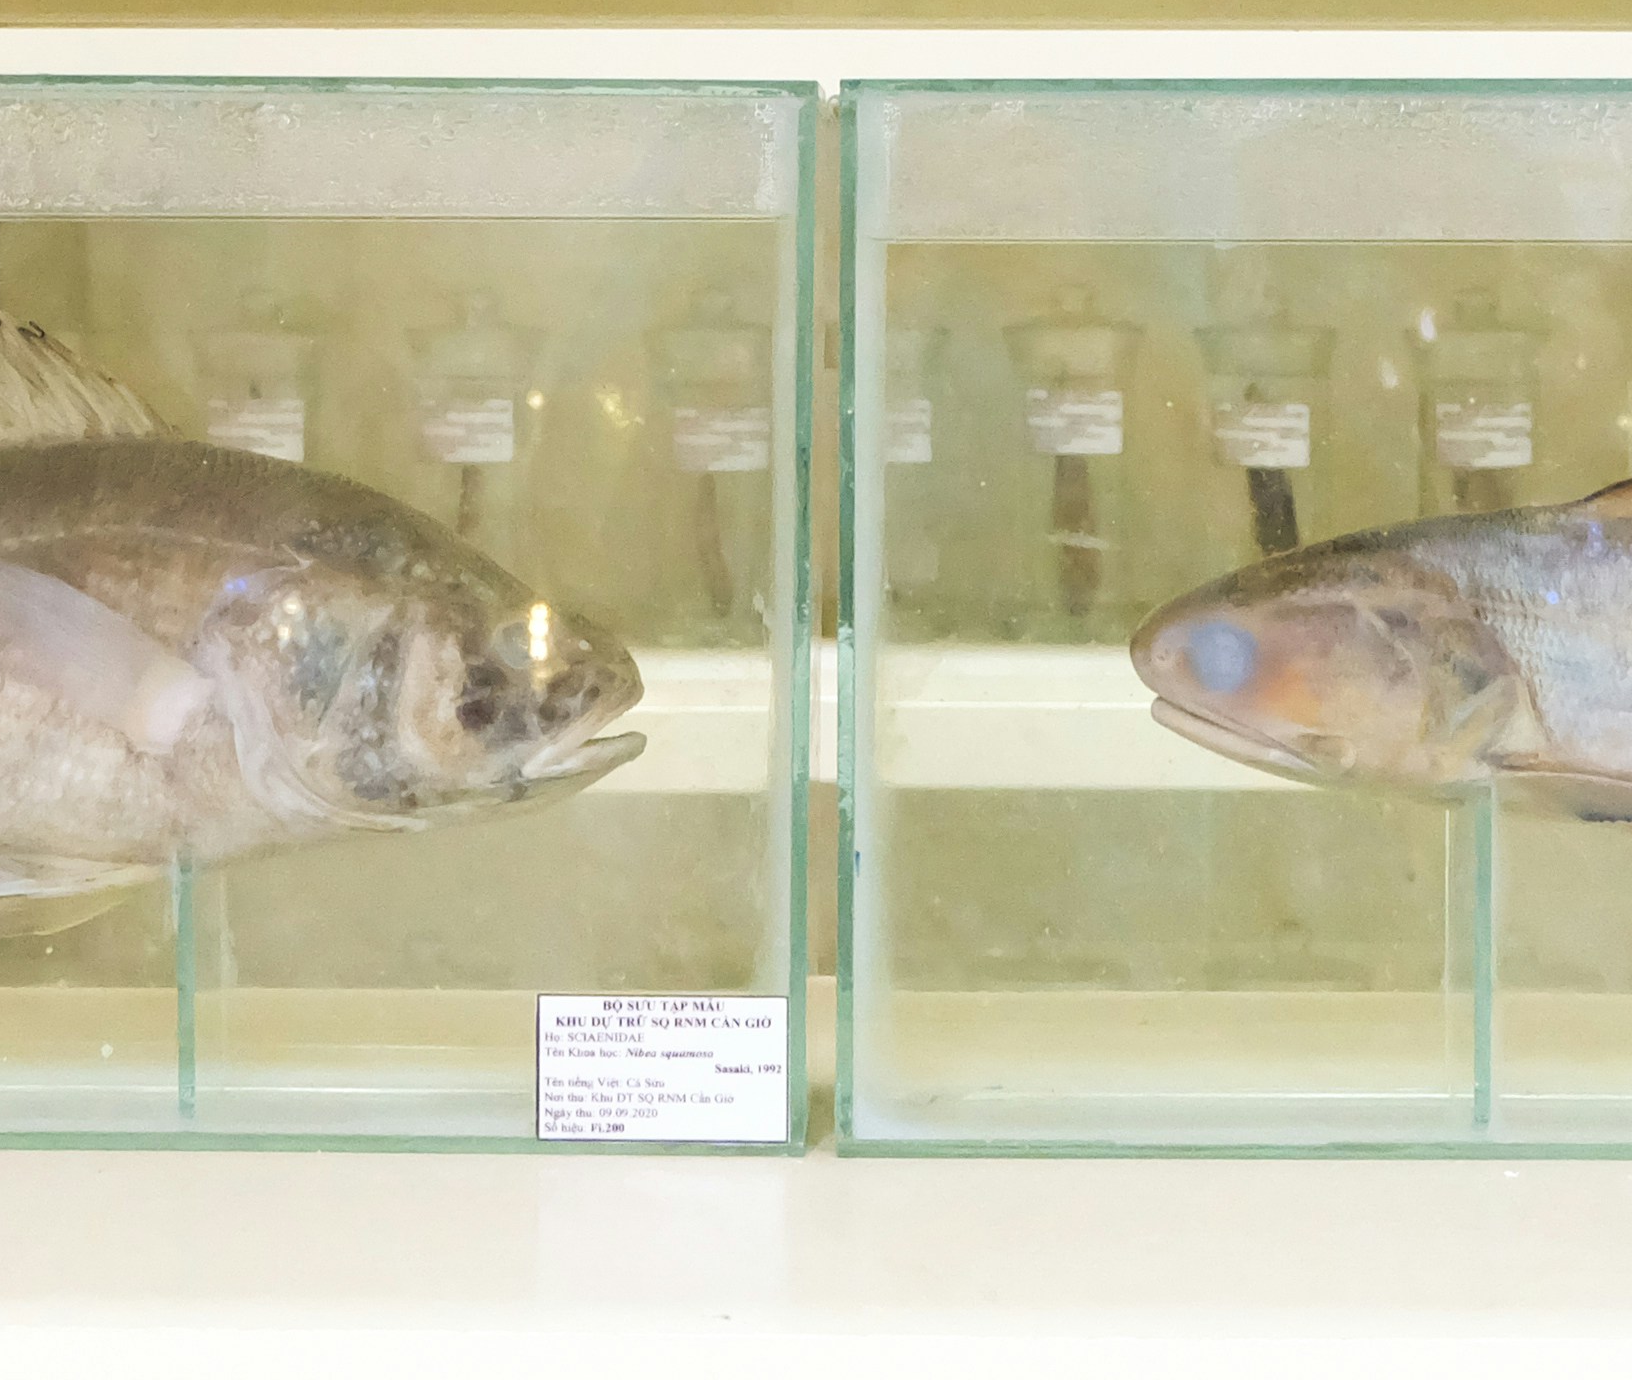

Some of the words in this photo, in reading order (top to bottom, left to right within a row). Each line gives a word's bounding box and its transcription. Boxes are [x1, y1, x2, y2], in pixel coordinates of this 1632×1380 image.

[556, 1017, 586, 1027] KHU
[651, 1018, 669, 1029] SQ
[674, 1018, 706, 1028] RNM
[715, 1064, 753, 1075] Sasaki,
[757, 1065, 781, 1074] 1992
[638, 1093, 654, 1105] SQ
[658, 1094, 686, 1103] RNM
